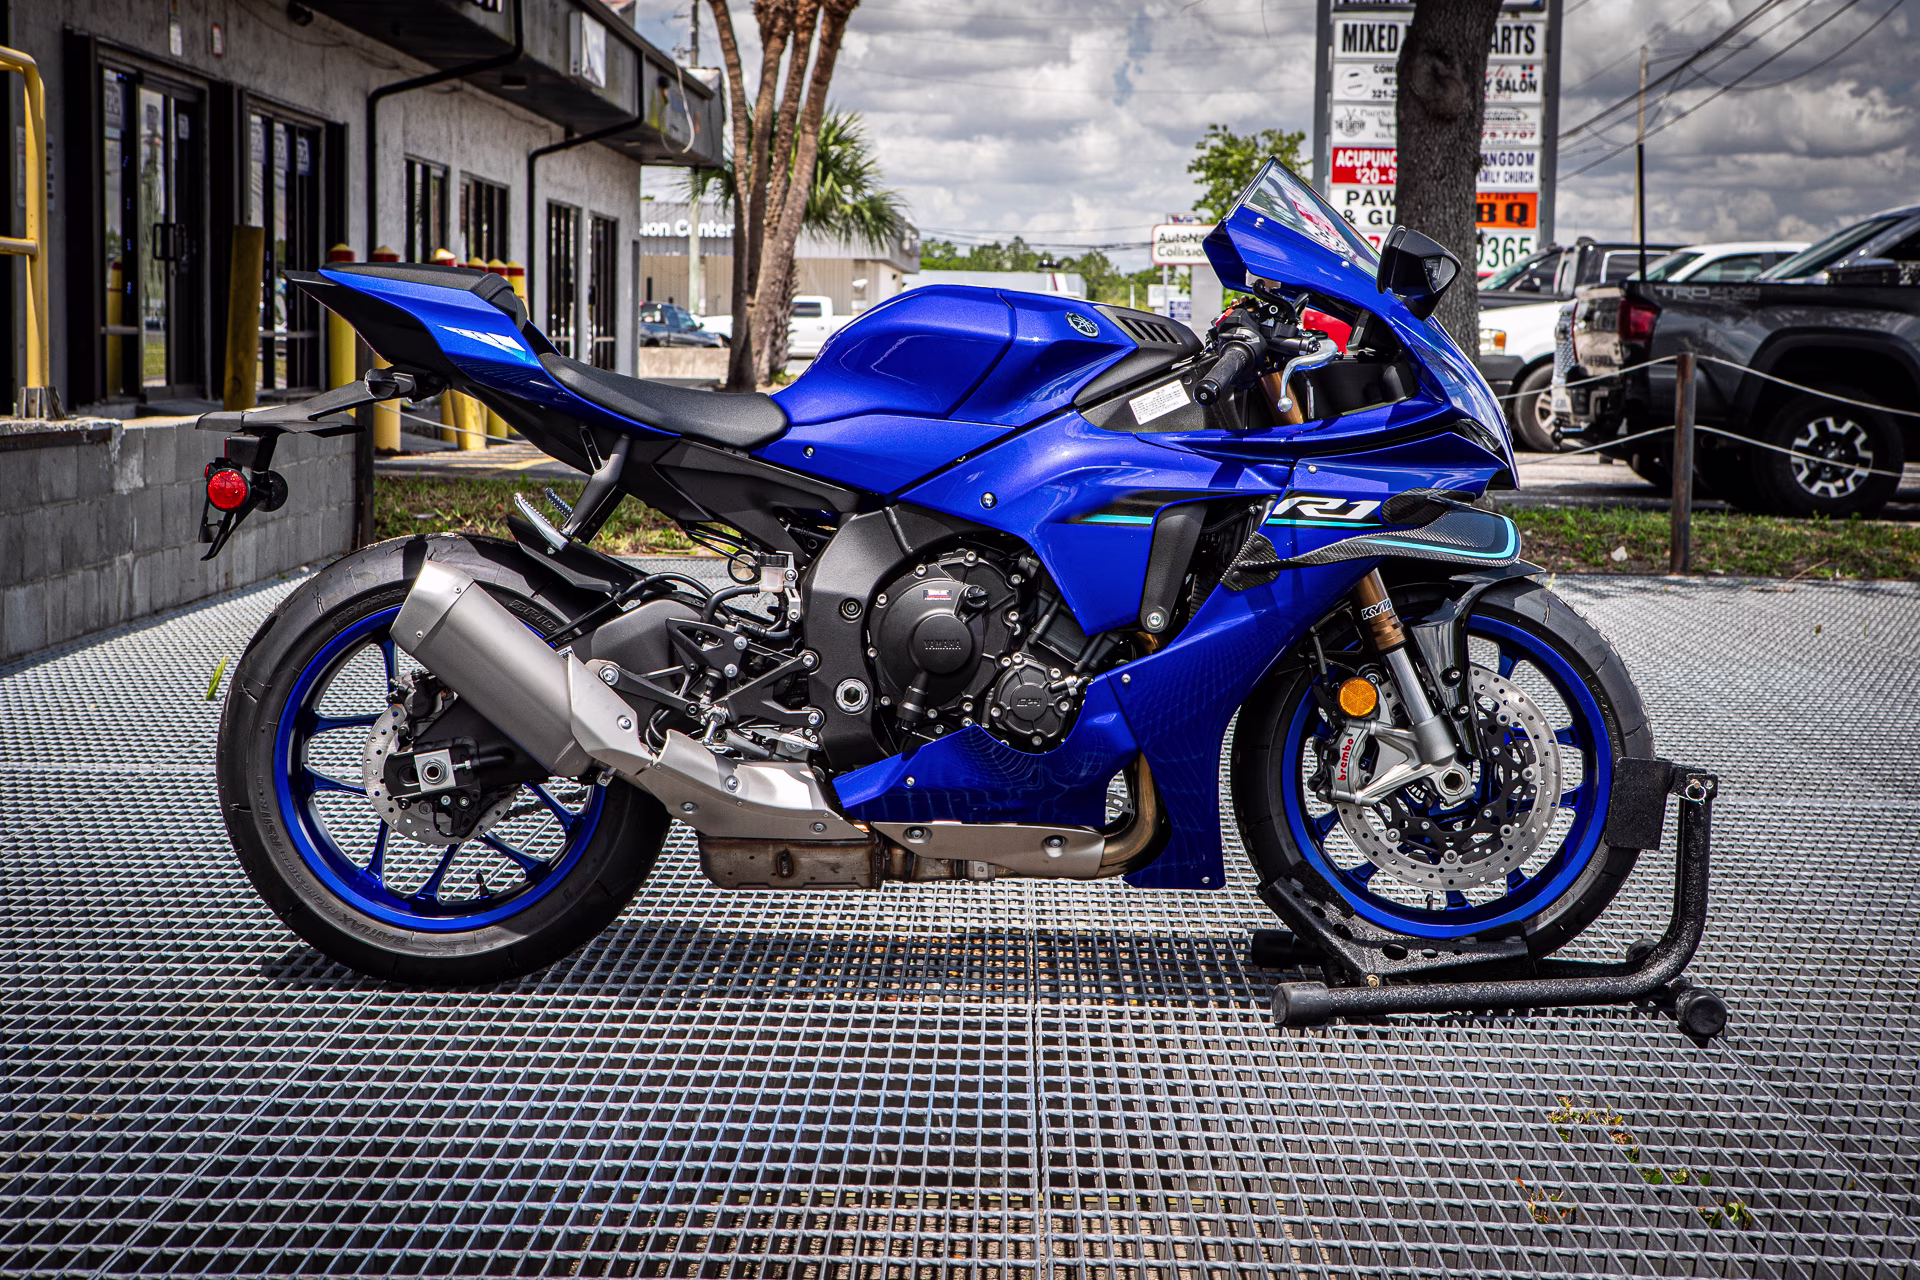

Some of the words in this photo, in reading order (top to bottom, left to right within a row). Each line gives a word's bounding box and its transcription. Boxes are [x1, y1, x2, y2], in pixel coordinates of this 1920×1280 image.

[1342, 23, 1398, 53] MIXED
[1496, 78, 1537, 93] SALON
[1504, 170, 1534, 184] CHURCH
[1344, 209, 1356, 225] &
[1271, 496, 1381, 520] R1
[1361, 598, 1392, 620] KYB
[924, 640, 961, 650] YAMAHA
[1337, 738, 1354, 780] brembo
